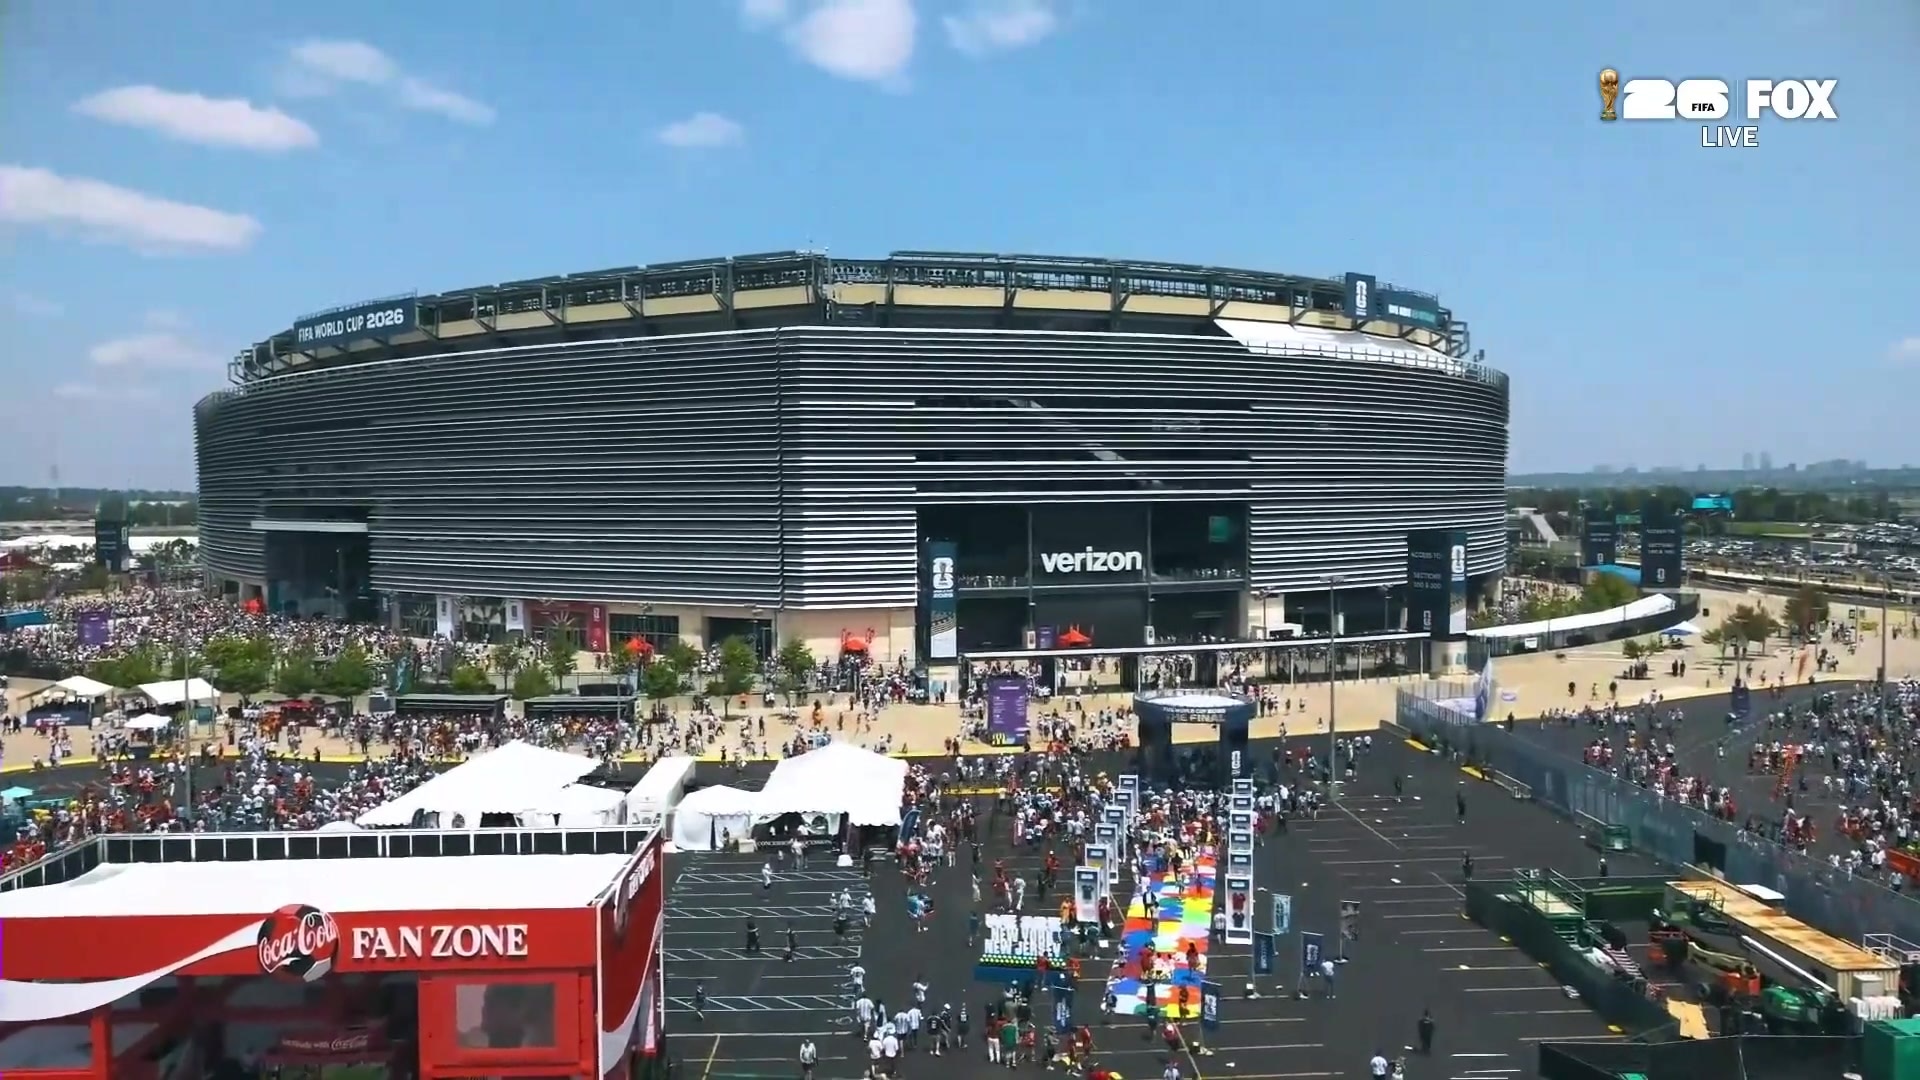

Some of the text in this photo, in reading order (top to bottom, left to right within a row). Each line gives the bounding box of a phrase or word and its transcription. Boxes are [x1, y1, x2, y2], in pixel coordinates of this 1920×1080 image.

[298, 308, 404, 342] FIFA WORLD CUP 2026
[1041, 546, 1143, 573] verizon
[1190, 714, 1225, 722] FINAL
[259, 912, 341, 973] Coca-Cola
[352, 924, 529, 960] FAN ZONE
